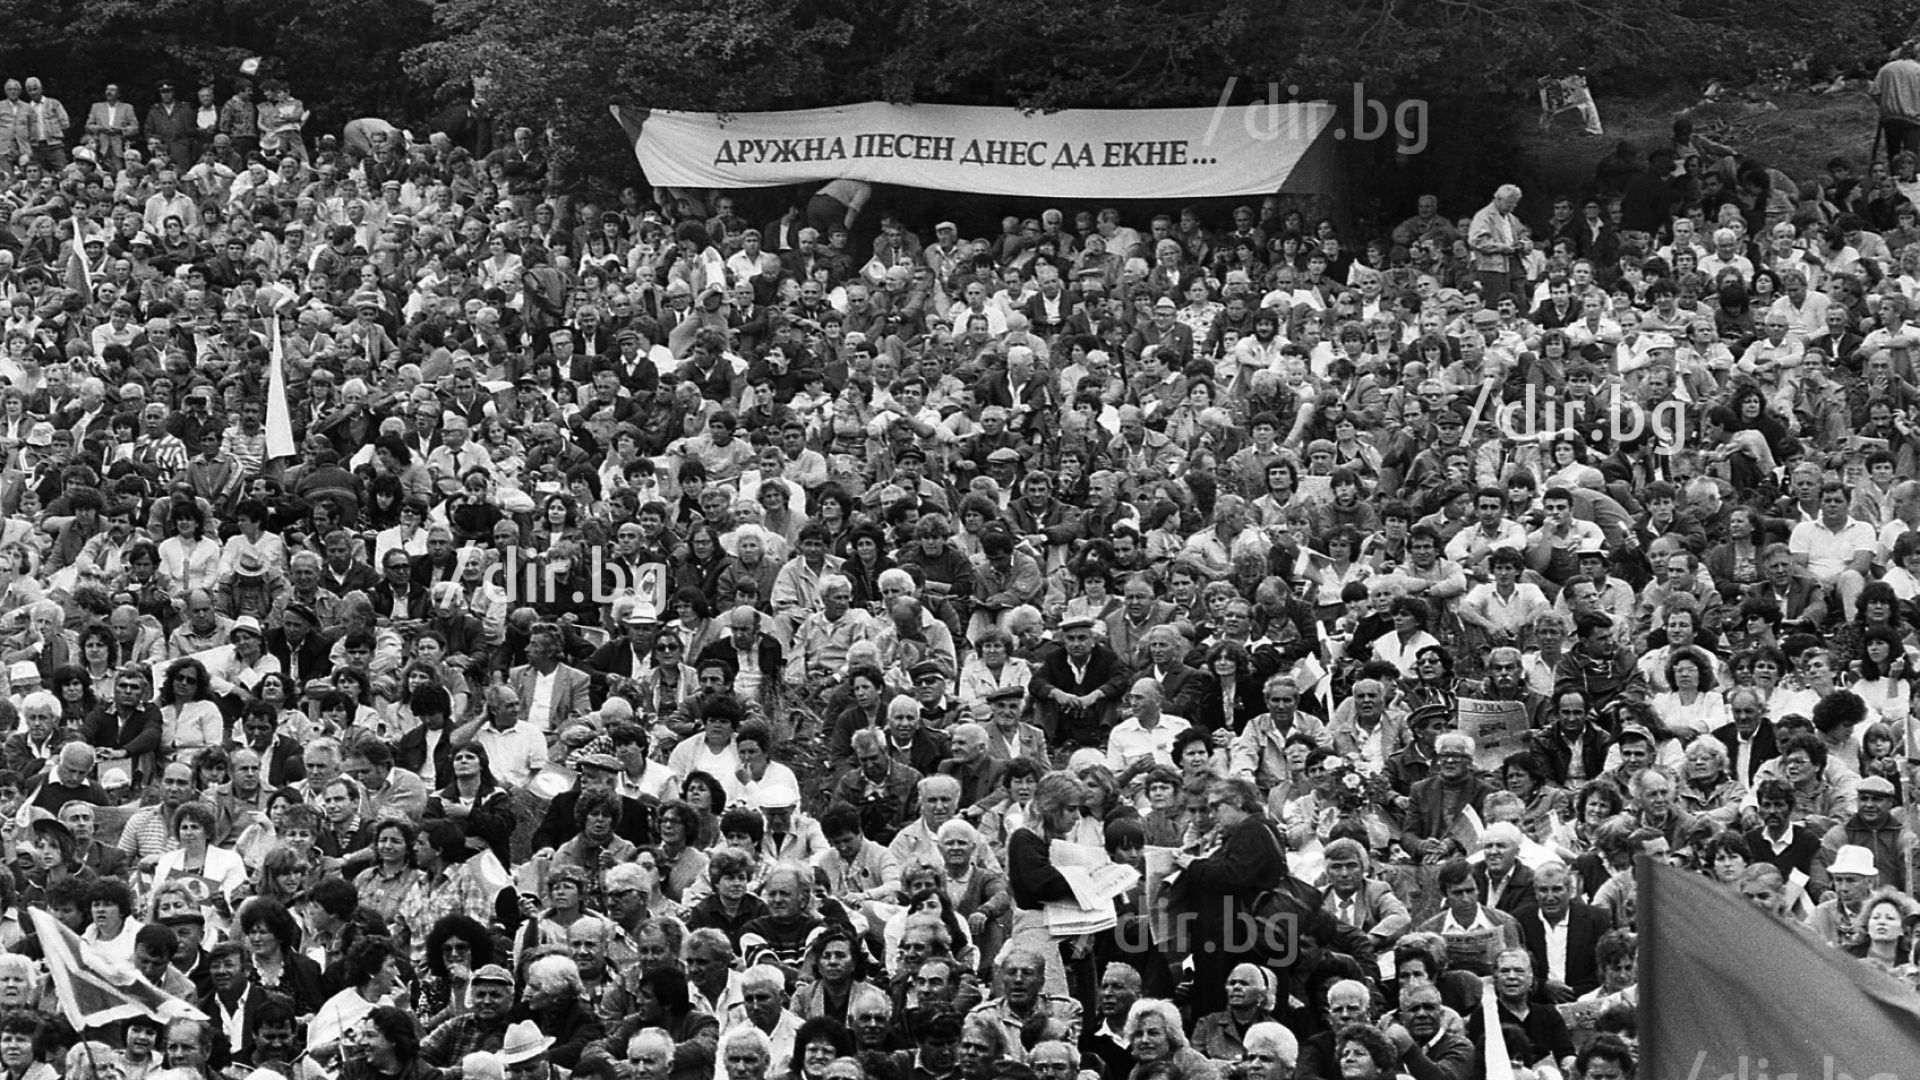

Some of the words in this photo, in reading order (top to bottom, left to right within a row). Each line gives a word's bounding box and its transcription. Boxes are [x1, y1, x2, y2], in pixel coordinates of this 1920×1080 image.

[714, 136, 847, 166] ДРУЖНА
[852, 133, 955, 161] ПЕСЕН
[959, 138, 1048, 167] ДНЕС
[1051, 142, 1096, 170] ДА
